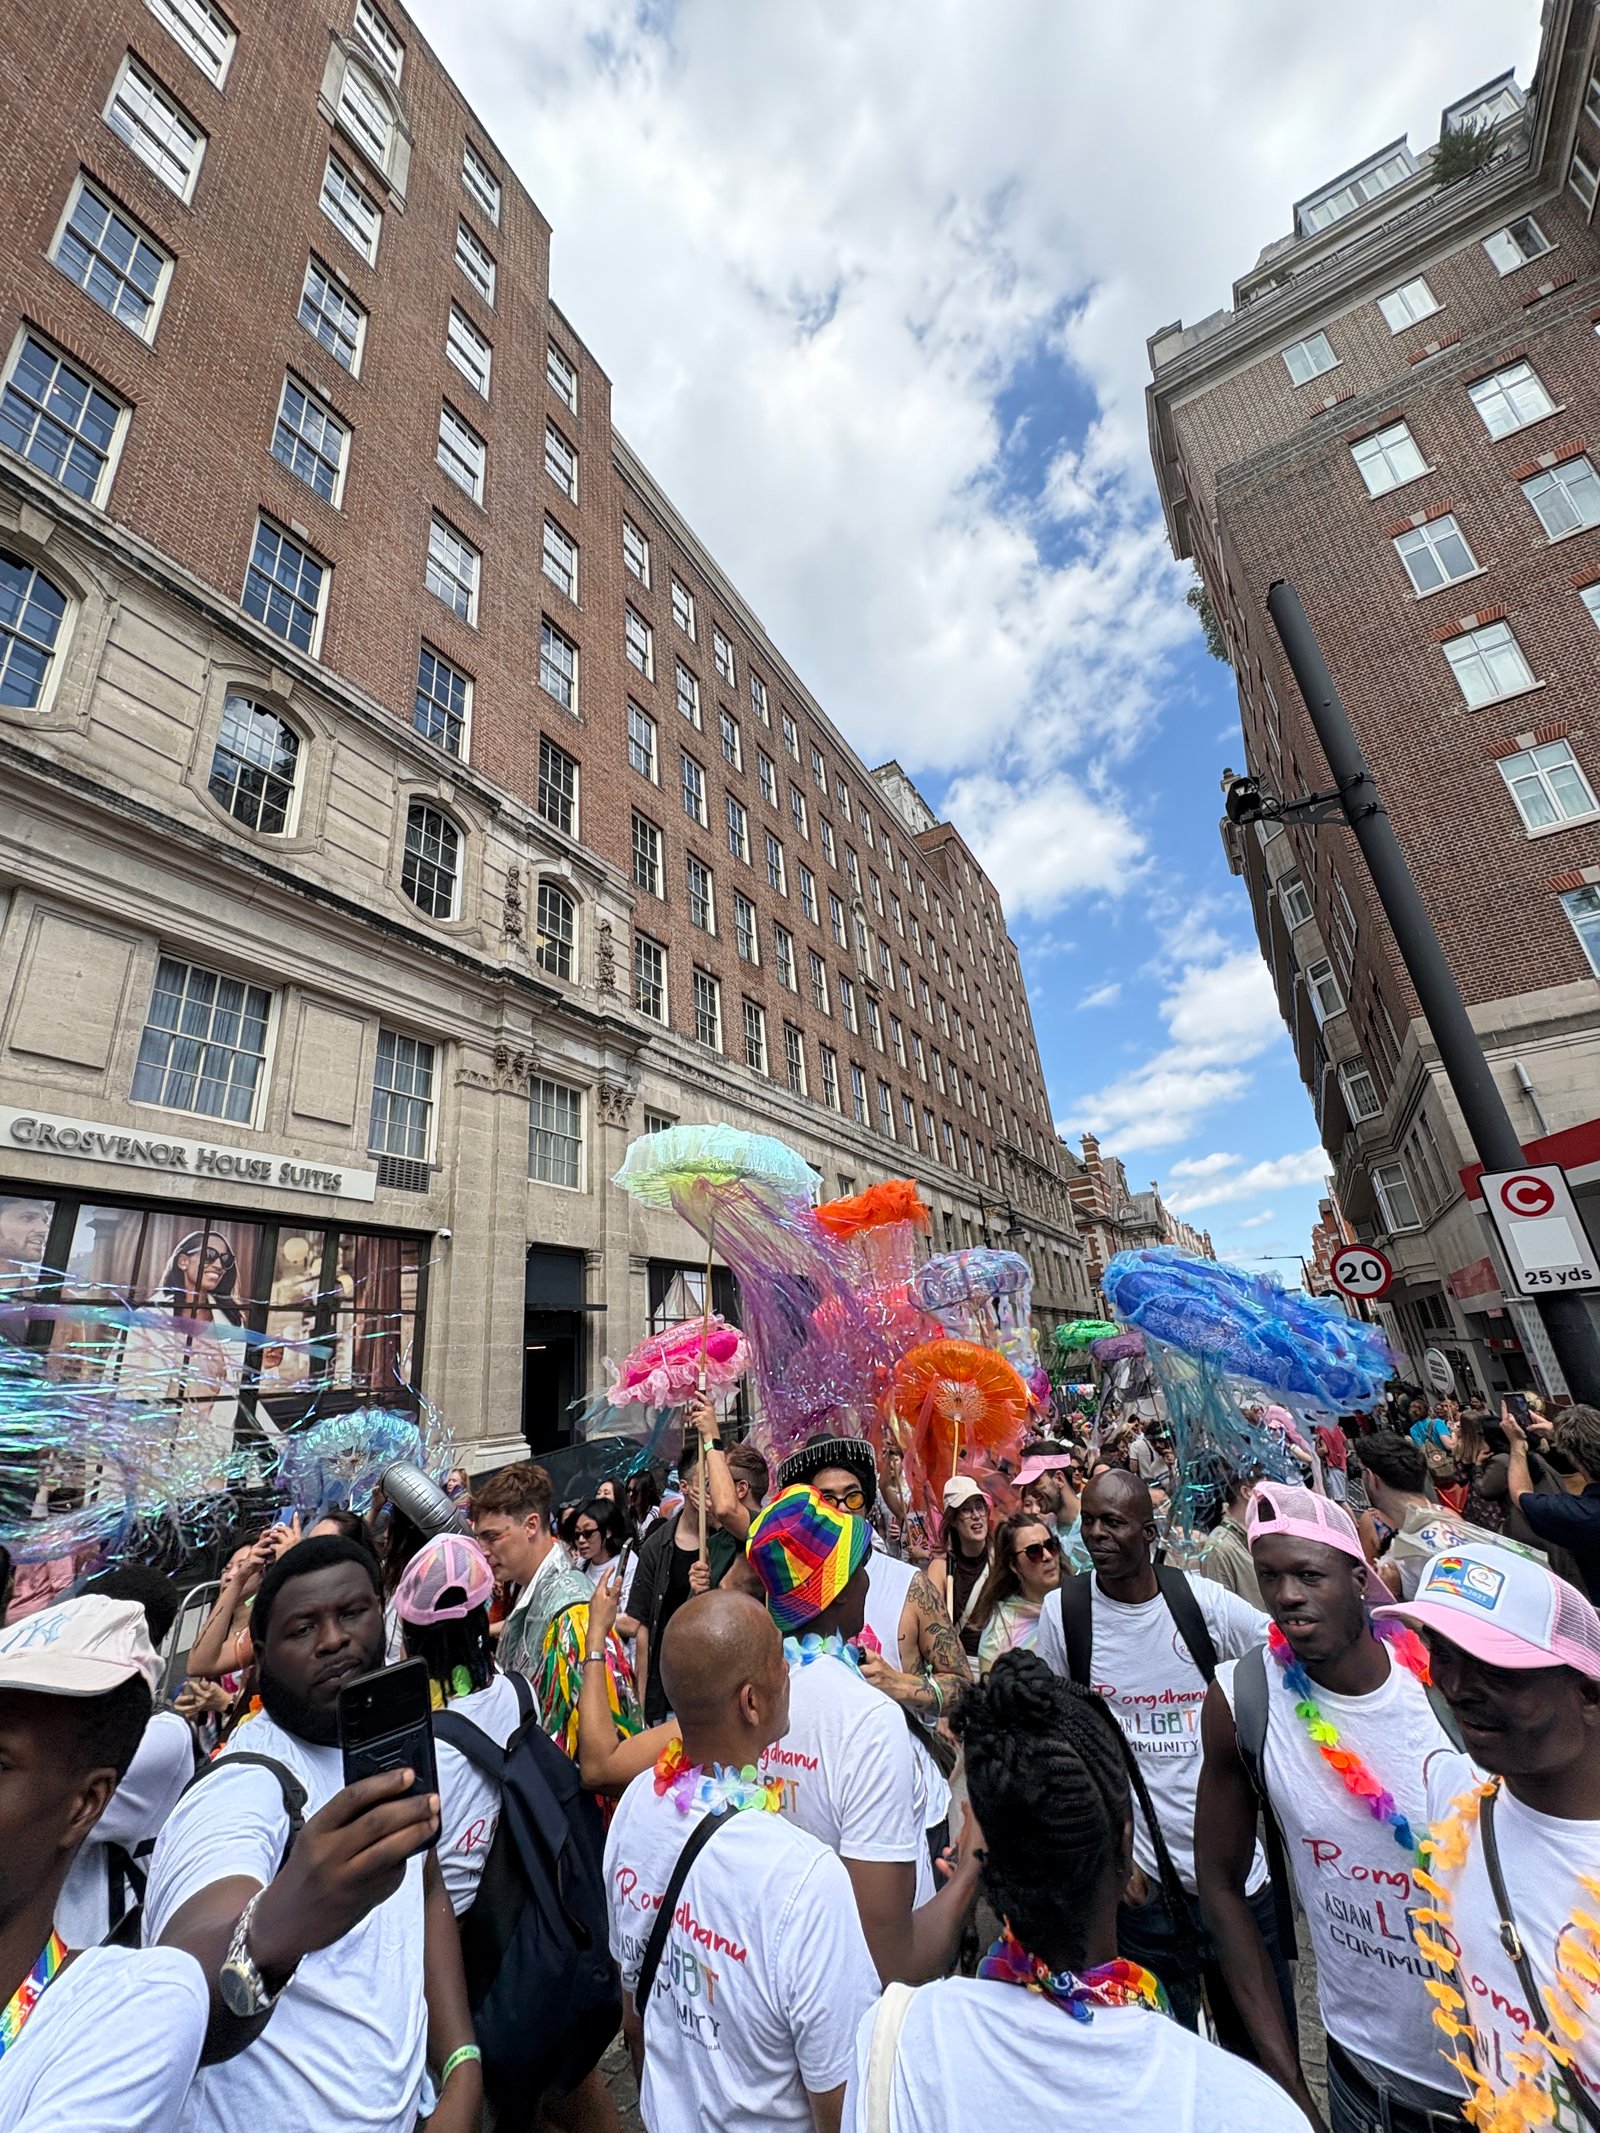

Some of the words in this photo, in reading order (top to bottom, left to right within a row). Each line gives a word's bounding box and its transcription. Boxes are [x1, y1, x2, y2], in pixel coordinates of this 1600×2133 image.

[10, 1116, 188, 1167] GROSVENOR
[195, 1147, 272, 1180] HOUSE
[279, 1162, 343, 1192] SUITES
[1338, 1259, 1383, 1285] 20
[1524, 1269, 1553, 1286] 25
[1556, 1266, 1593, 1286] yds
[1135, 1709, 1197, 1735] LGBT
[759, 1740, 819, 1771] gdhanu
[1324, 1892, 1374, 1934] ASIAN
